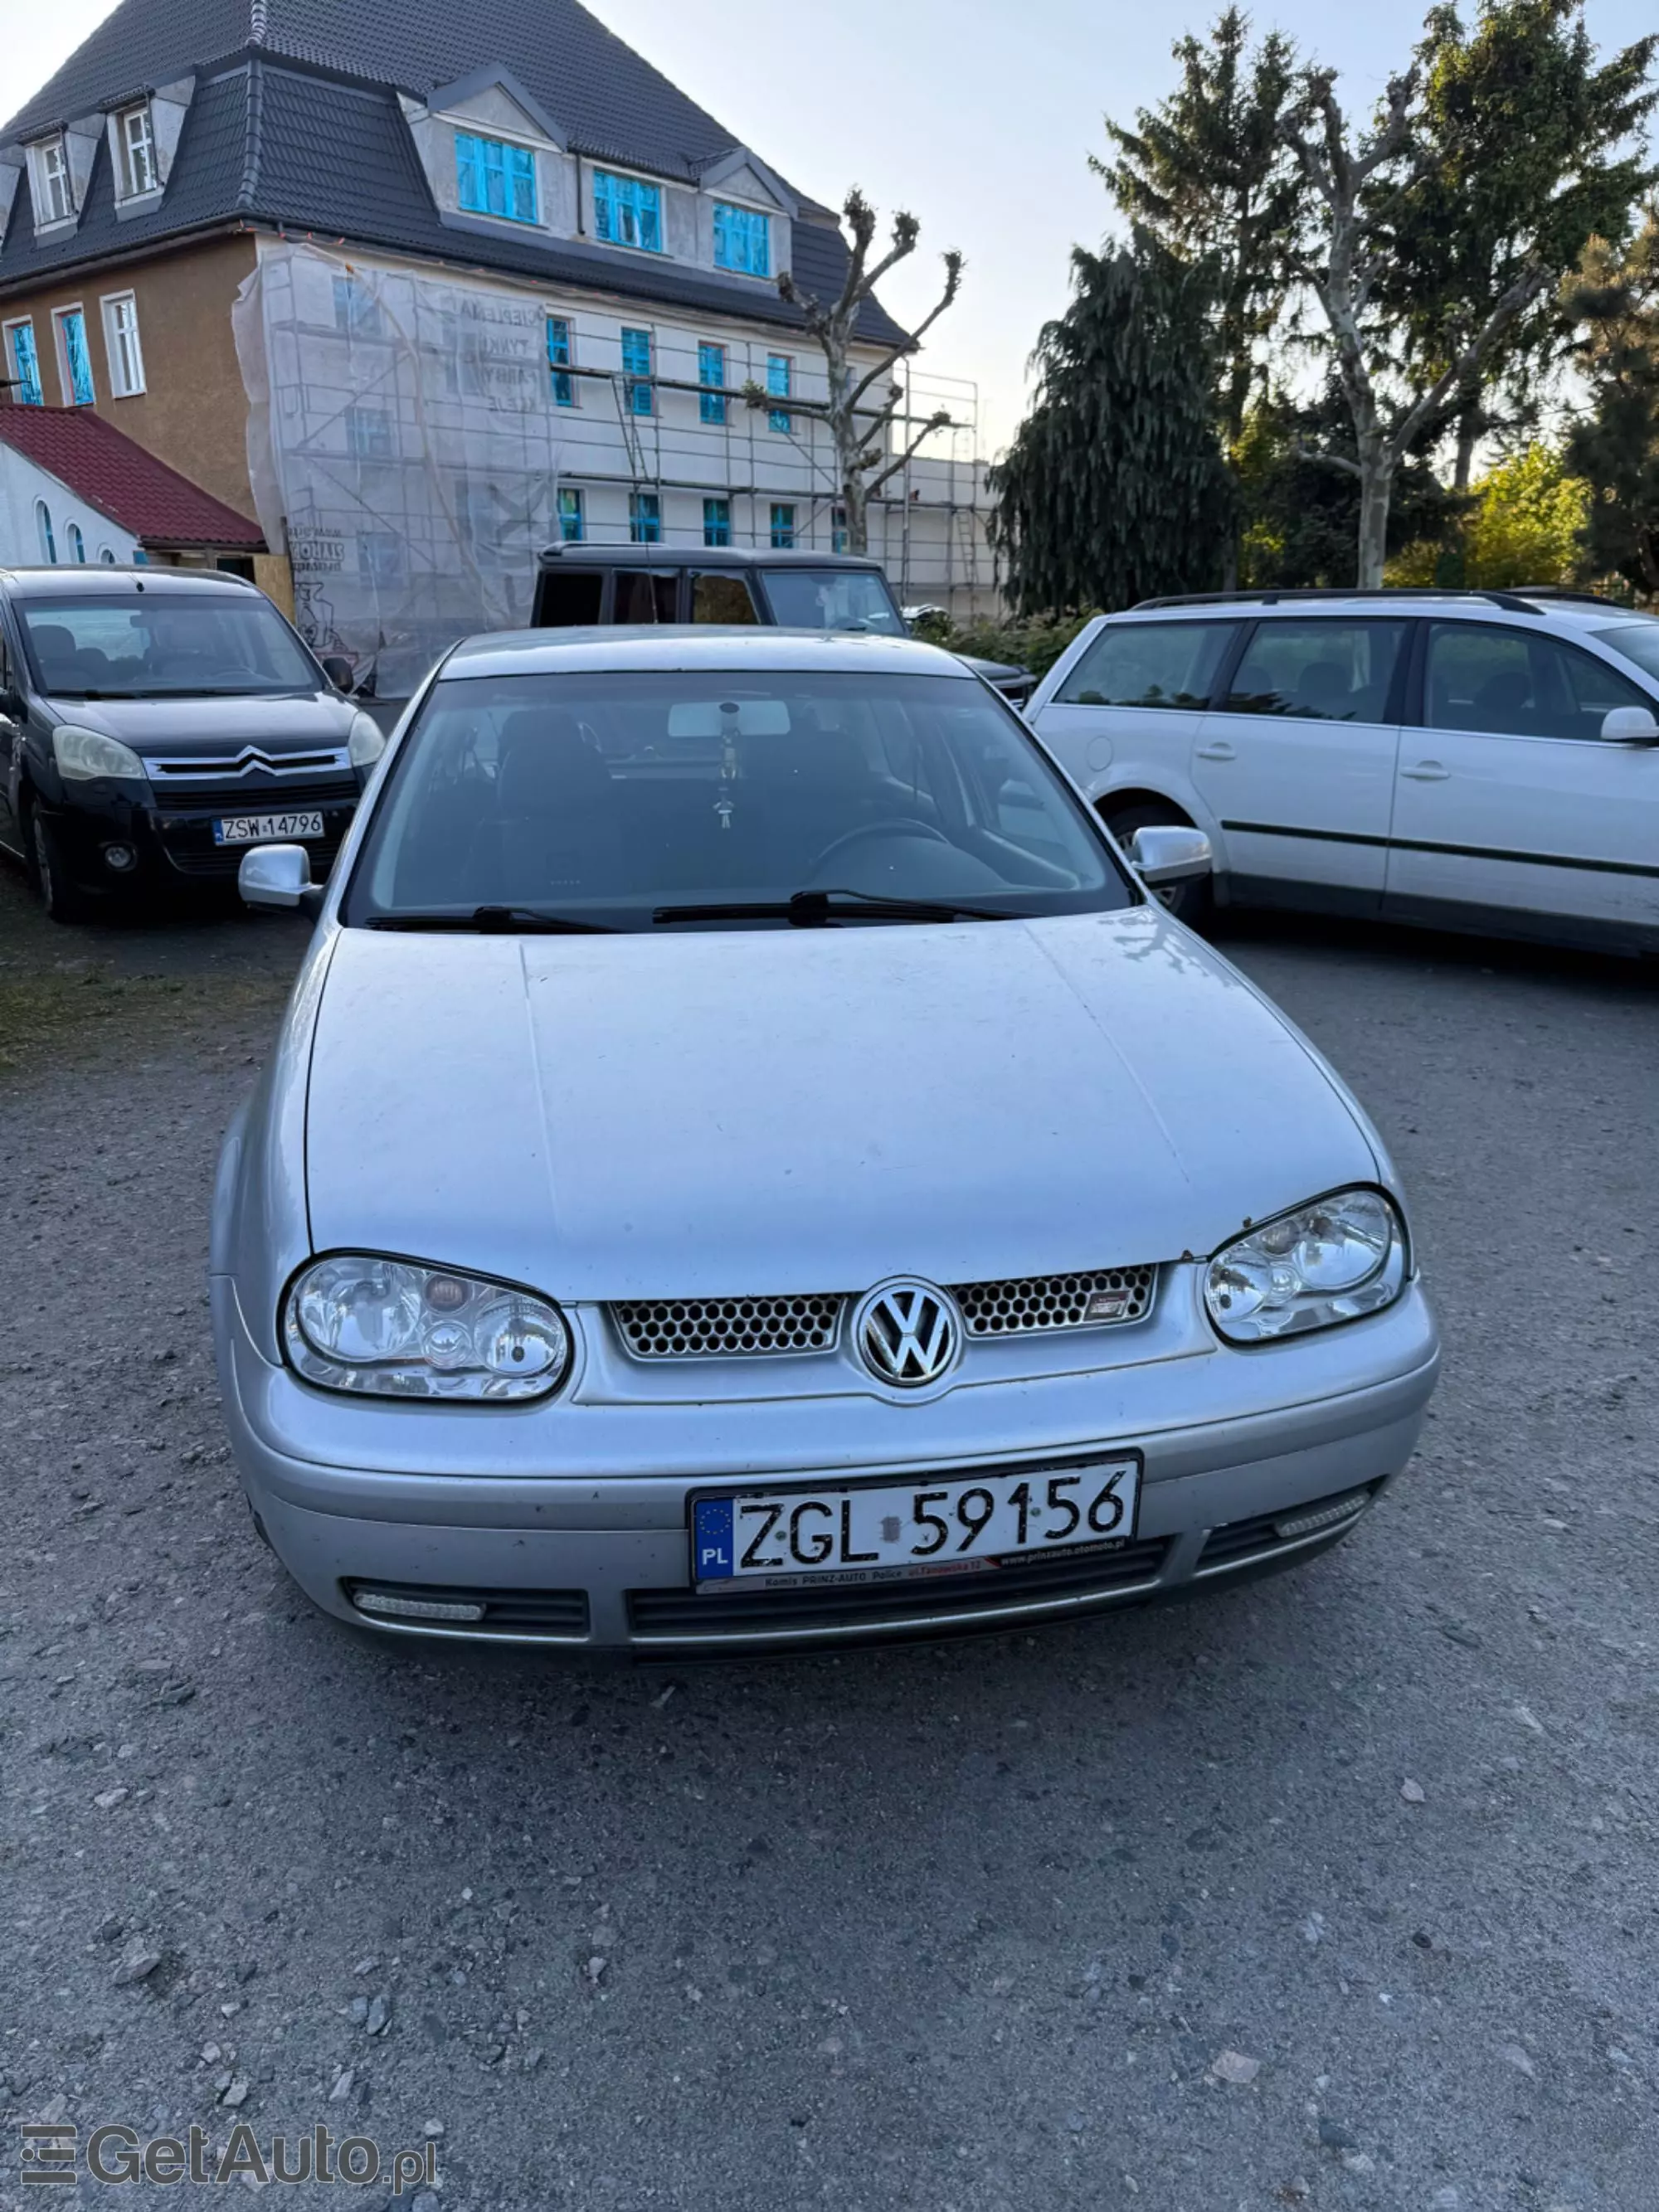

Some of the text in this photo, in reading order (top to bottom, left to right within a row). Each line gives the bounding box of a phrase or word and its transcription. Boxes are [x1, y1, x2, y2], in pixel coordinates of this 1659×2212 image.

[223, 814, 322, 839] ZSW 14796
[741, 1470, 1127, 1568] ZGL 59156
[702, 1548, 728, 1565] PL
[765, 1577, 798, 1587] Komis
[802, 1572, 867, 1586] PRINZ-AUTO
[873, 1568, 902, 1581] Police
